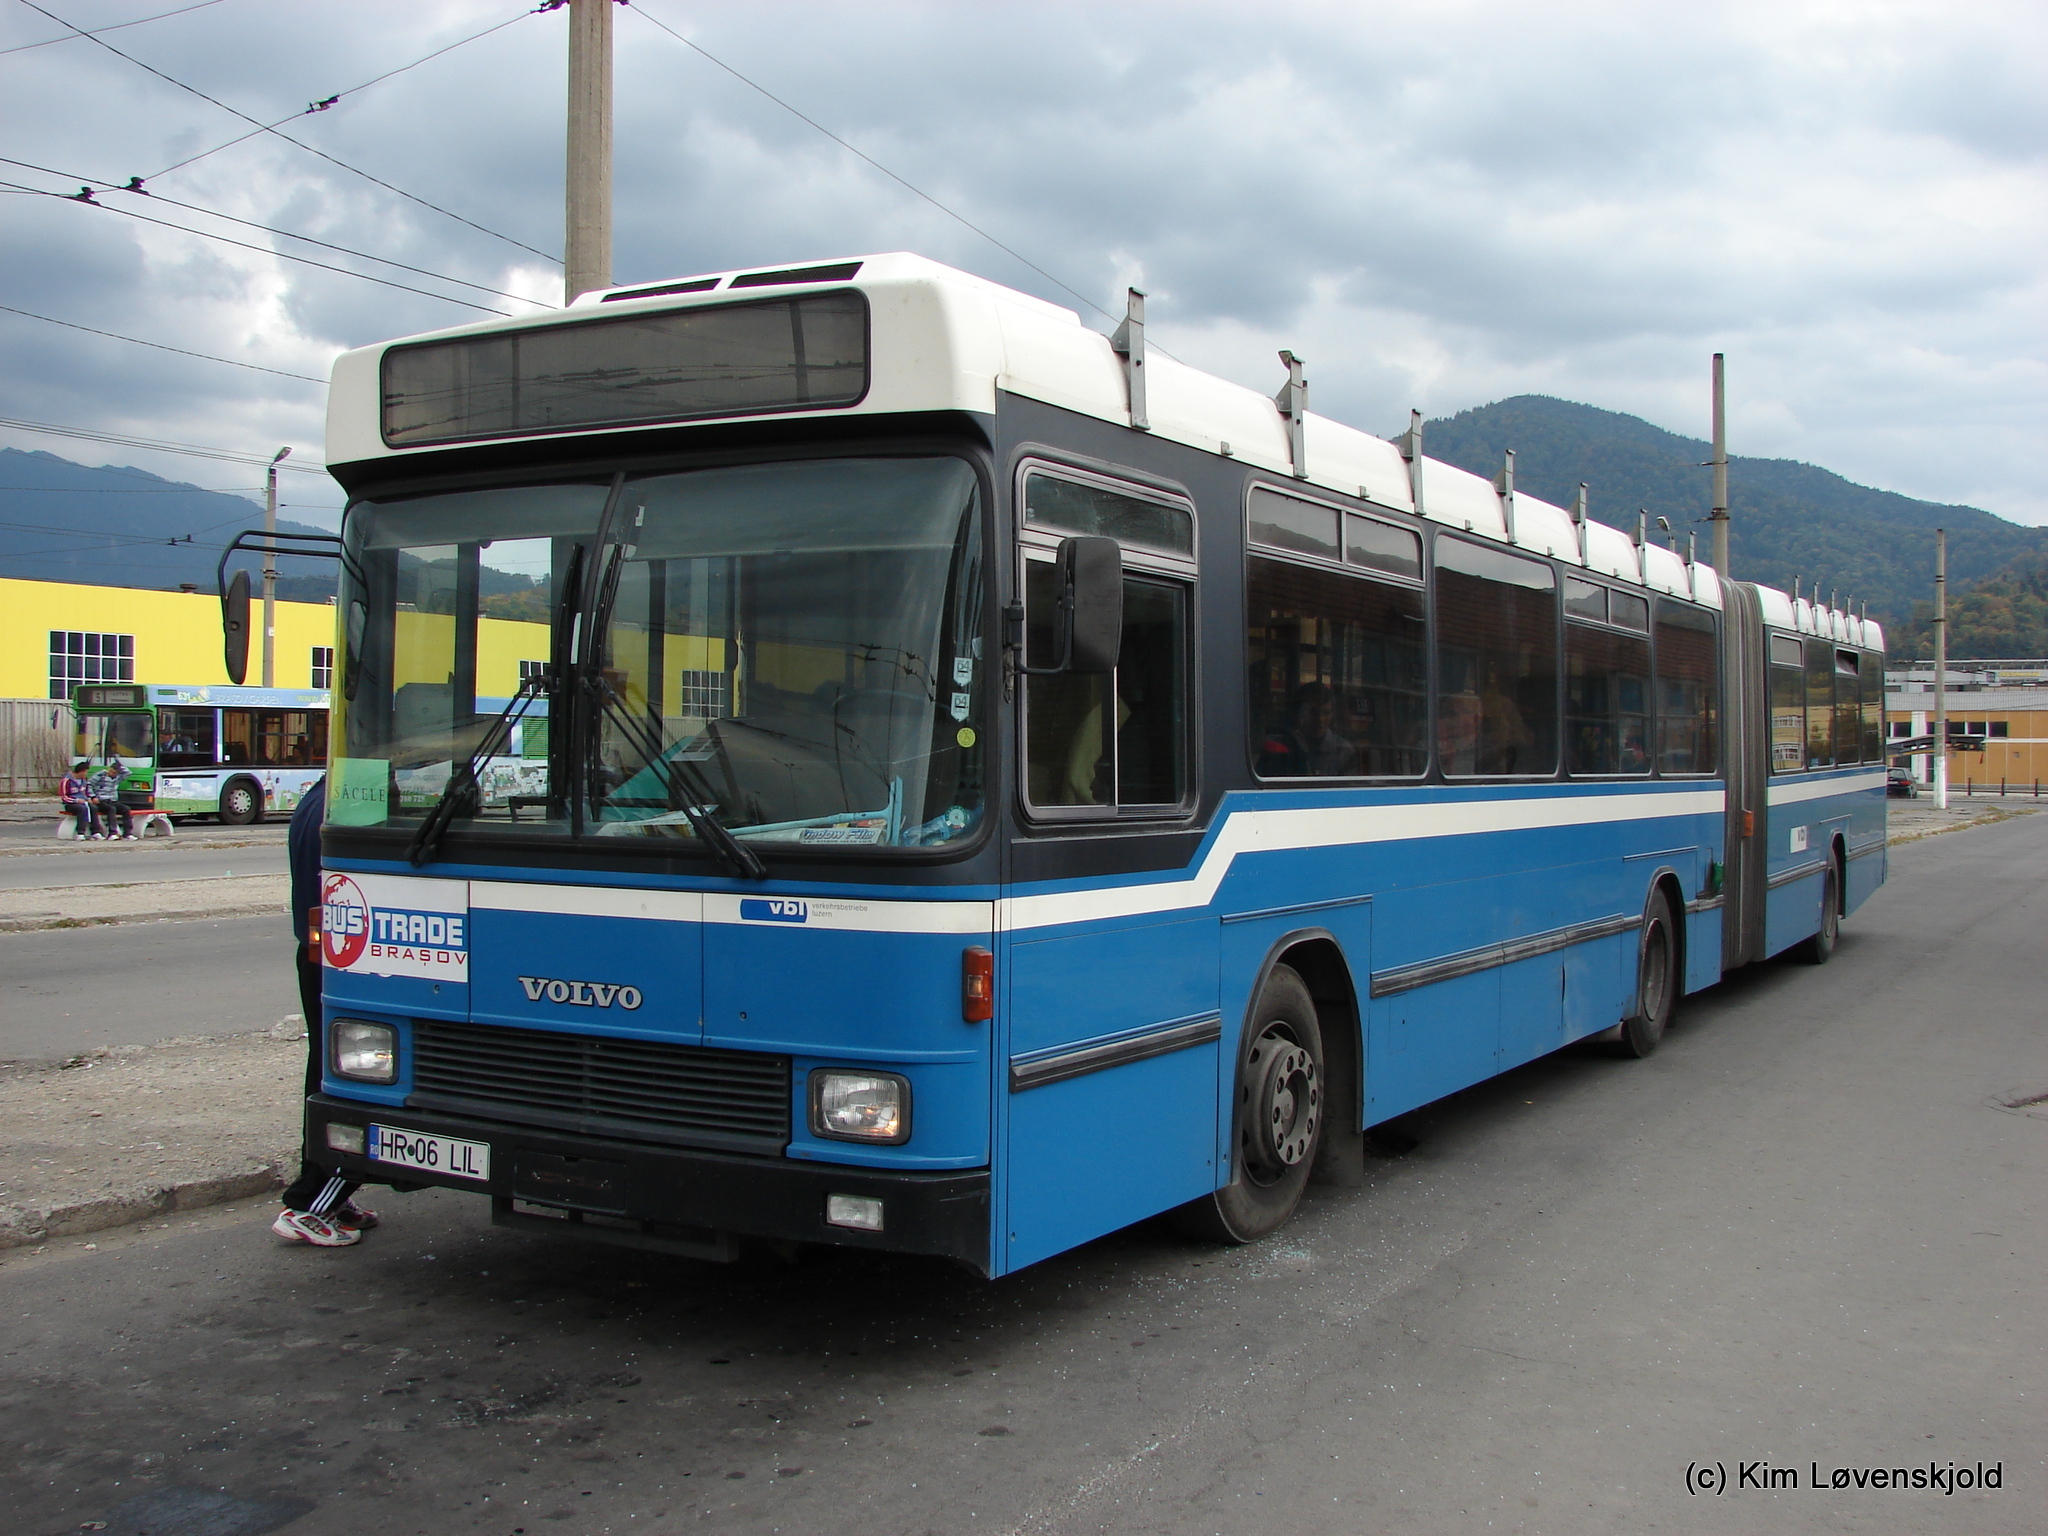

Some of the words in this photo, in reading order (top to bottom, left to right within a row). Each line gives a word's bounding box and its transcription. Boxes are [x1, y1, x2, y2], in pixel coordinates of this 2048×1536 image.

[177, 691, 191, 701] 631
[846, 829, 876, 840] Film
[769, 901, 805, 916] vbl
[812, 902, 868, 912] verkehrsbetriebe
[812, 910, 833, 918] luzern
[323, 905, 364, 935] BUS
[374, 911, 463, 947] TRADE
[519, 976, 642, 1010] VOLVO
[450, 1143, 480, 1175] LIL
